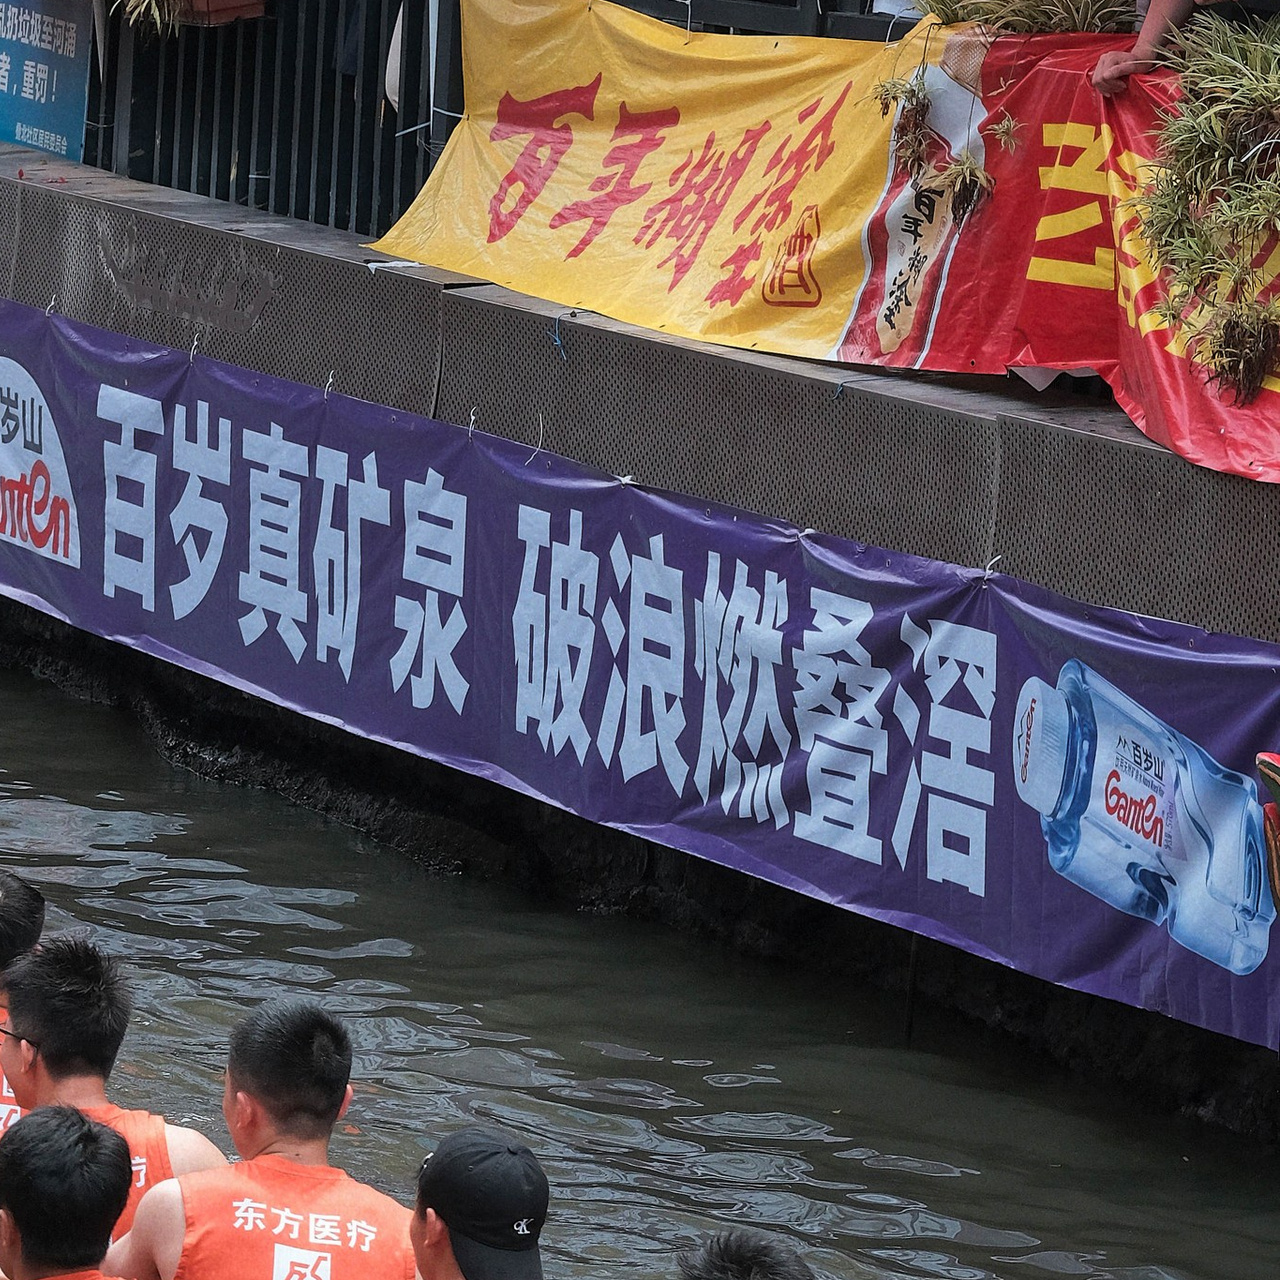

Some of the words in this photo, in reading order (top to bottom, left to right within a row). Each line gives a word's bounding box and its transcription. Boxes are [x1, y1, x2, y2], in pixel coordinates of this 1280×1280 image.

[96, 382, 468, 717] 百岁真矿泉
[510, 503, 998, 898] 破浪燃叠滘
[1130, 739, 1166, 781] 百岁山
[1104, 769, 1164, 848] Ganten
[231, 1197, 378, 1254] 东方医疗
